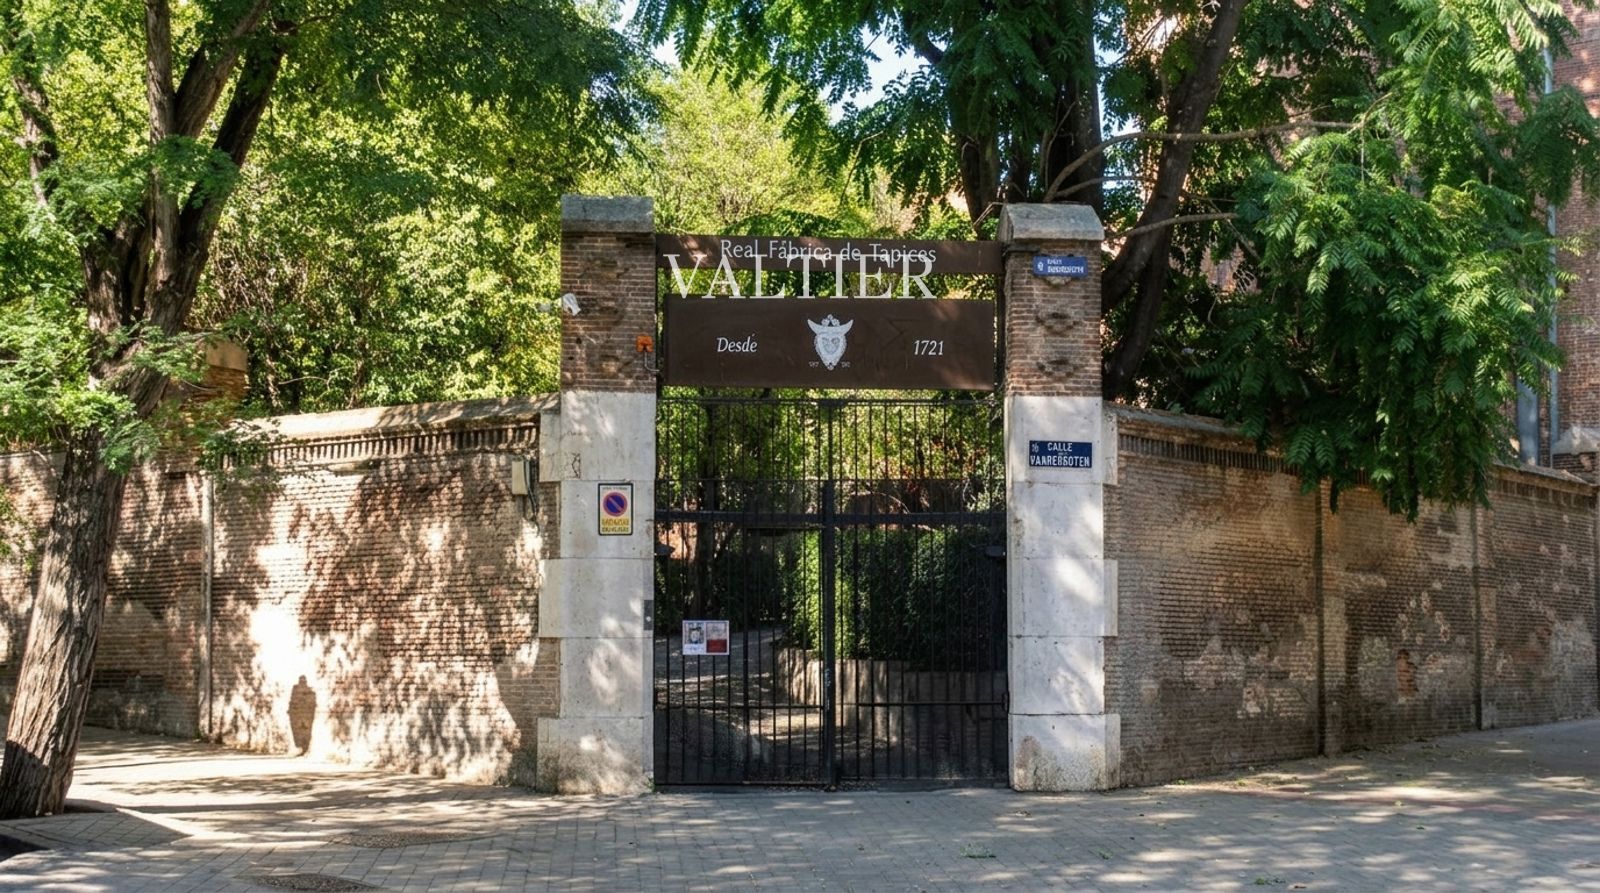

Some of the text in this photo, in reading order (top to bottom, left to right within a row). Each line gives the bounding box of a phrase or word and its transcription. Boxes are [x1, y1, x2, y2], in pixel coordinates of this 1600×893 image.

[720, 239, 937, 269] Real Fábrica de Tapices
[914, 340, 944, 356] 1721
[1047, 442, 1073, 452] CALLE
